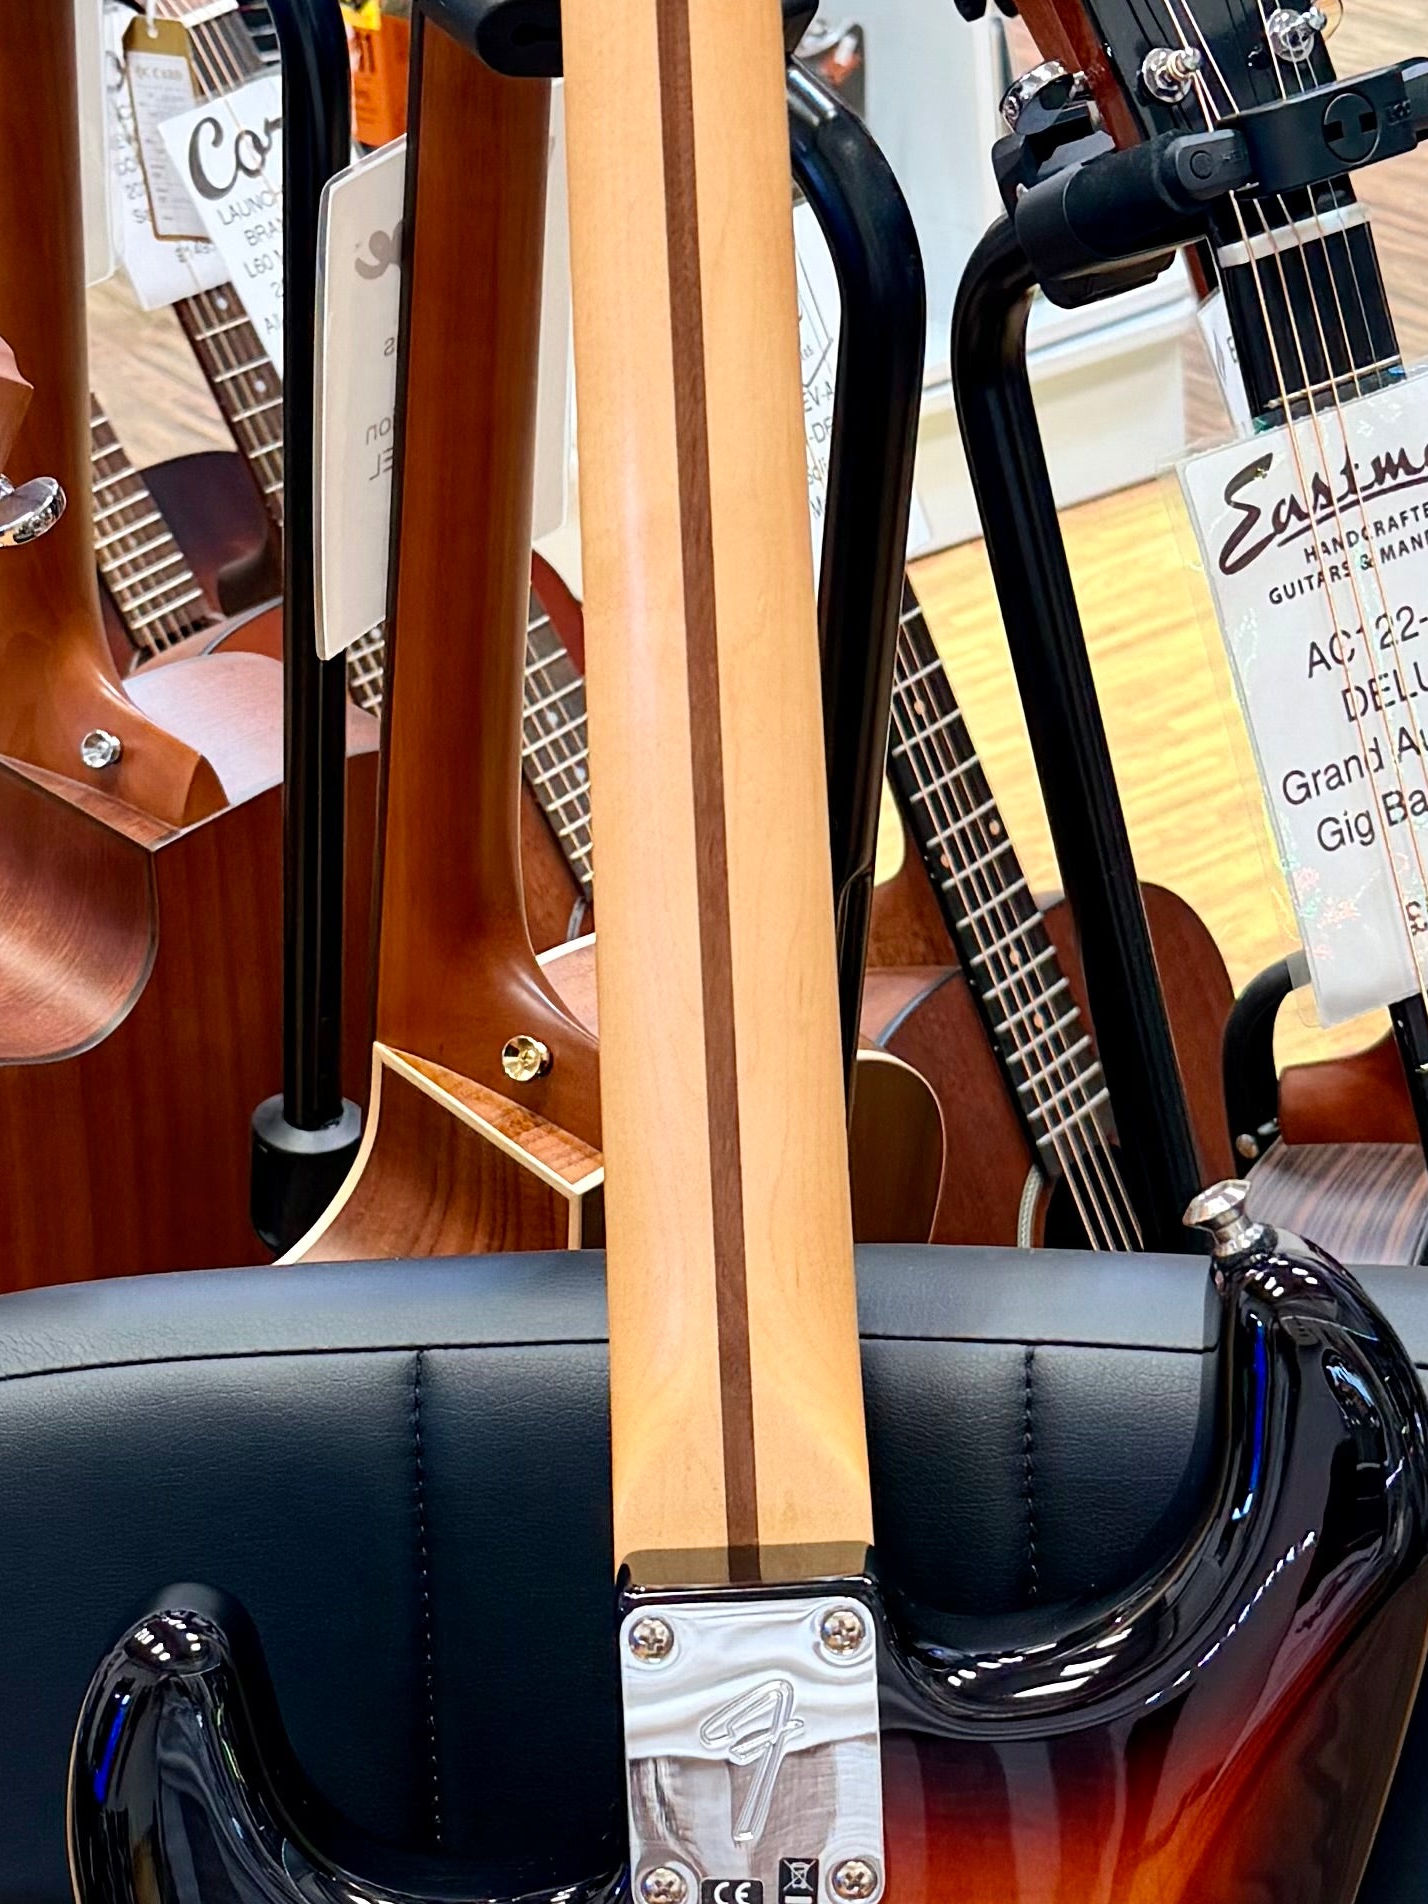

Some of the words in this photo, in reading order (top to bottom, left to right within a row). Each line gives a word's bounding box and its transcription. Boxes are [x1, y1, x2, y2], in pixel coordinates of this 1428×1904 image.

[1268, 559, 1356, 606] GUITARS
[1360, 552, 1374, 571] &
[1281, 736, 1385, 806] Grand
[1316, 809, 1376, 852] Gig
